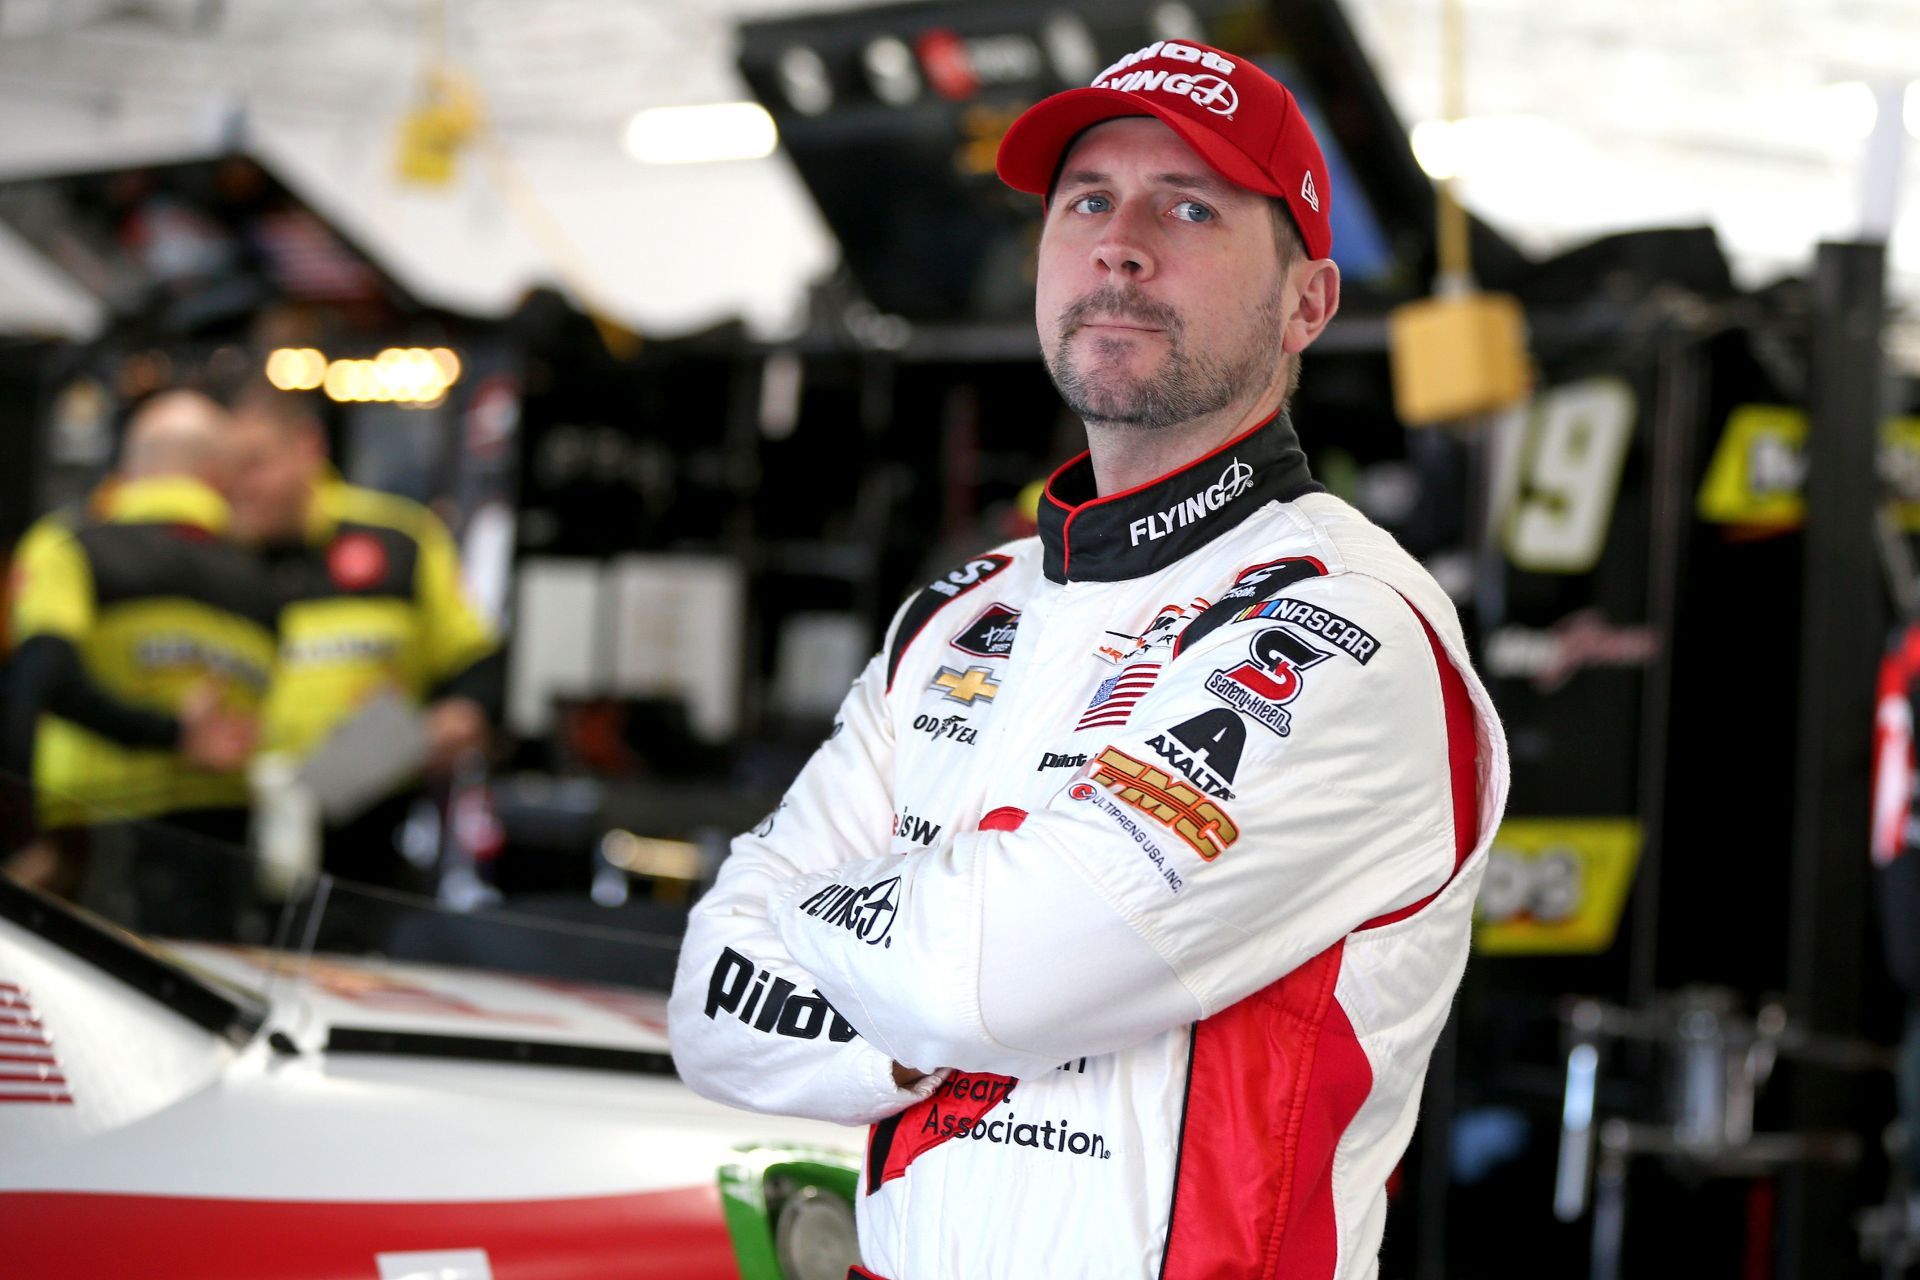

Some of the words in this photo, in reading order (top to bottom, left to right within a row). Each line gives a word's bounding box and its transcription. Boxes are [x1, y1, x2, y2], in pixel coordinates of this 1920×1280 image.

[1129, 484, 1226, 547] FLYING
[1270, 599, 1374, 661] NASCAR
[1145, 735, 1230, 800] AXALTA
[1092, 745, 1240, 862] TMC
[1163, 868, 1183, 893] INC.
